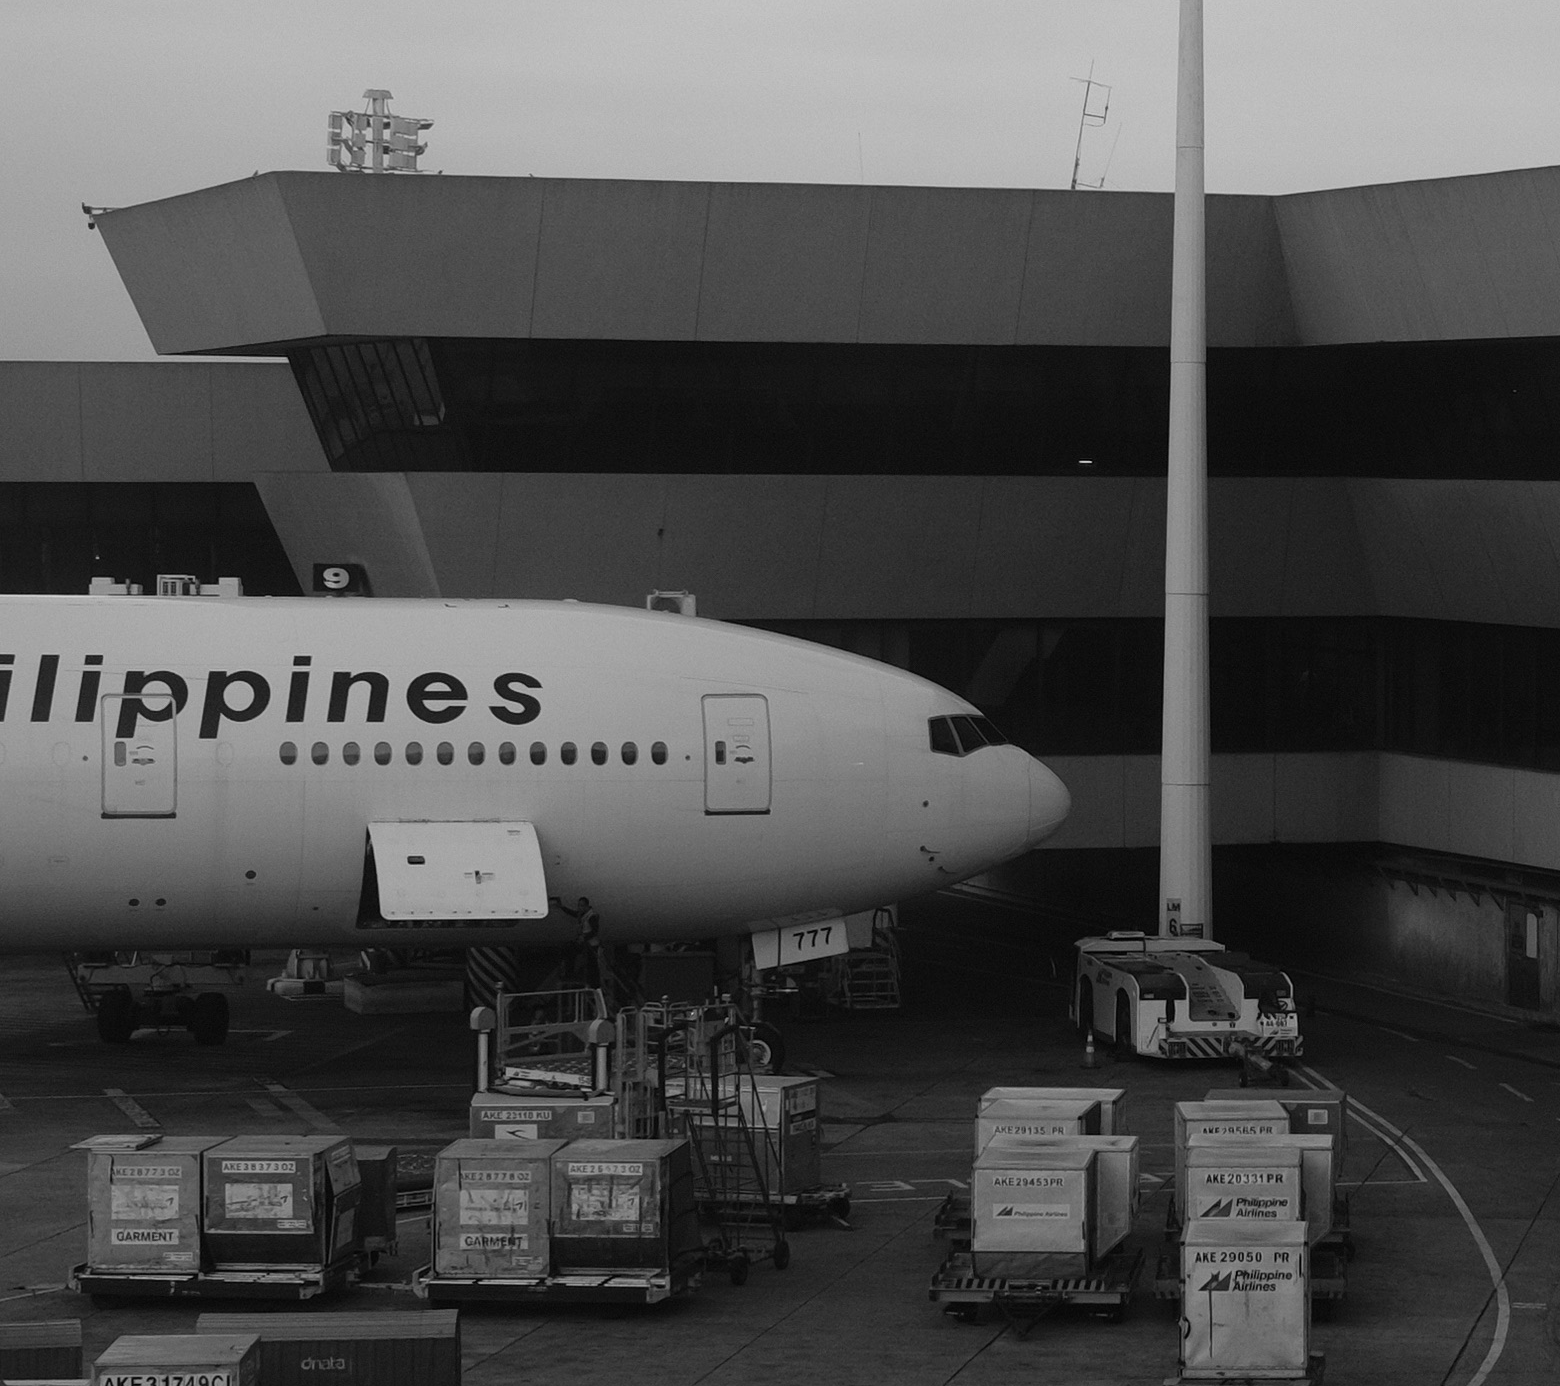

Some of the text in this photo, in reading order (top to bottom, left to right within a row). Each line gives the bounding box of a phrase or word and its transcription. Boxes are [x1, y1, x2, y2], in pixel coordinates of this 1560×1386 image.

[323, 567, 350, 589] 9
[793, 927, 832, 950] 777
[1236, 1197, 1289, 1209] Philippine
[1236, 1207, 1278, 1218] Airlines
[116, 1231, 174, 1242] GARMENT
[464, 1236, 523, 1247] GARMENT
[1195, 1251, 1290, 1263] AKE 29050 PR
[1235, 1269, 1294, 1281] Philippine
[1232, 1281, 1277, 1293] Airlines
[300, 1357, 346, 1371] dnata
